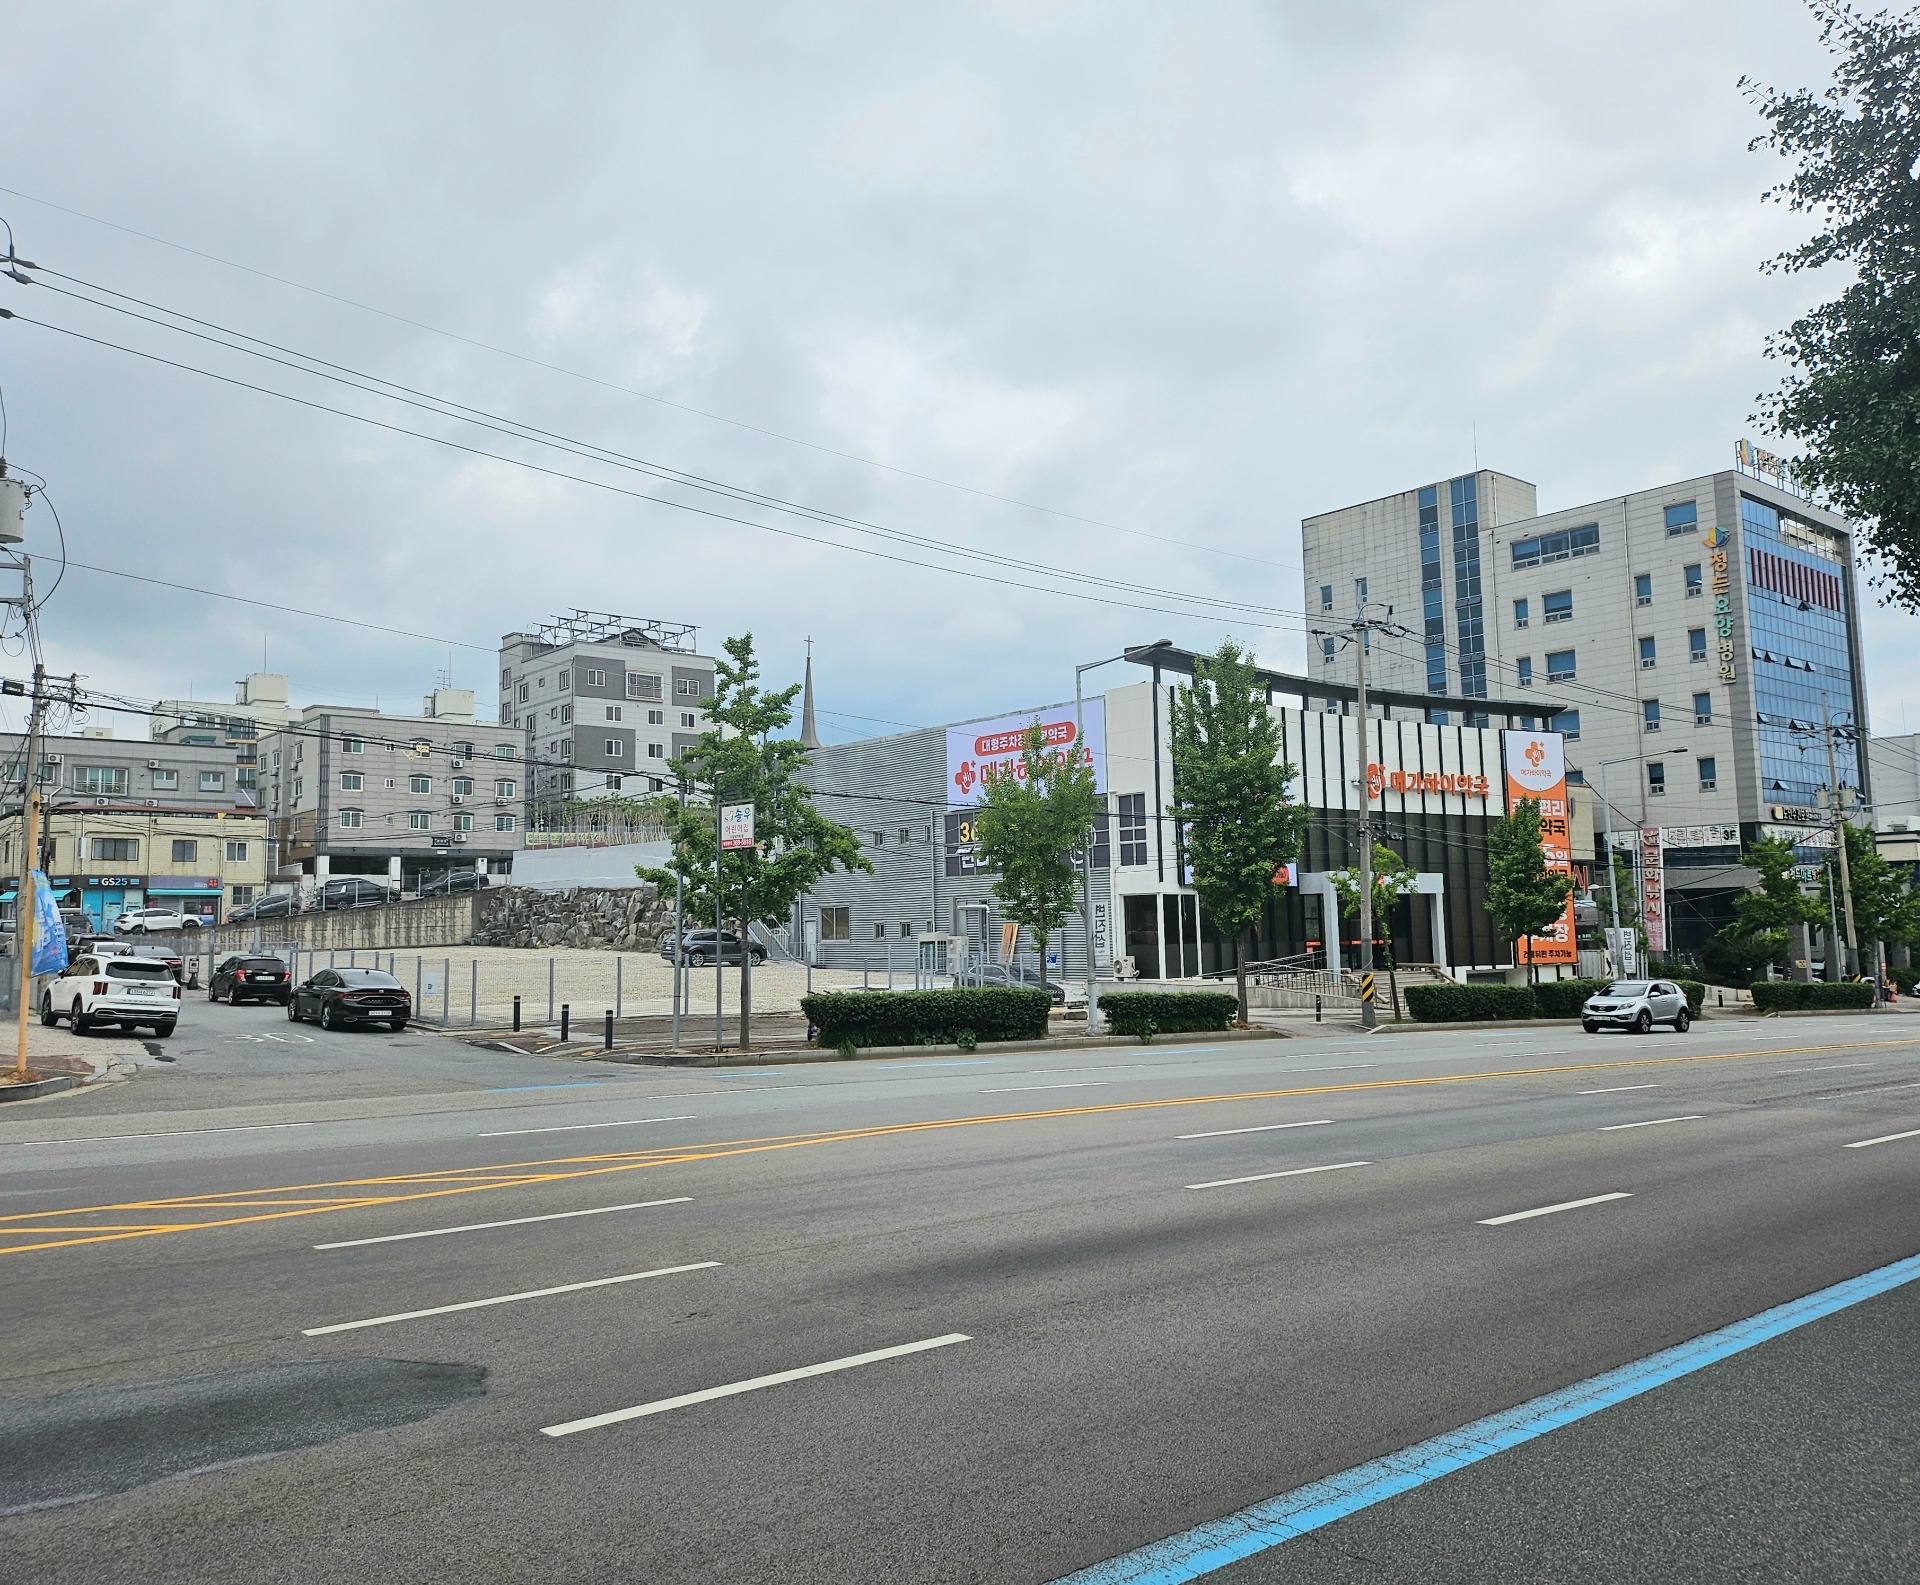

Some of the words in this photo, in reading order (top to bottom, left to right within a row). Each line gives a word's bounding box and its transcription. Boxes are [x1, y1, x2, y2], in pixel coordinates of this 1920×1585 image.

[1711, 550, 1736, 685] 정든요양병원
[1390, 771, 1489, 800] 메가하이약국
[725, 823, 749, 834] 어린이집
[101, 877, 128, 886] GS25
[1523, 950, 1547, 959] 건뒤편
[1548, 949, 1573, 958] 주차가능
